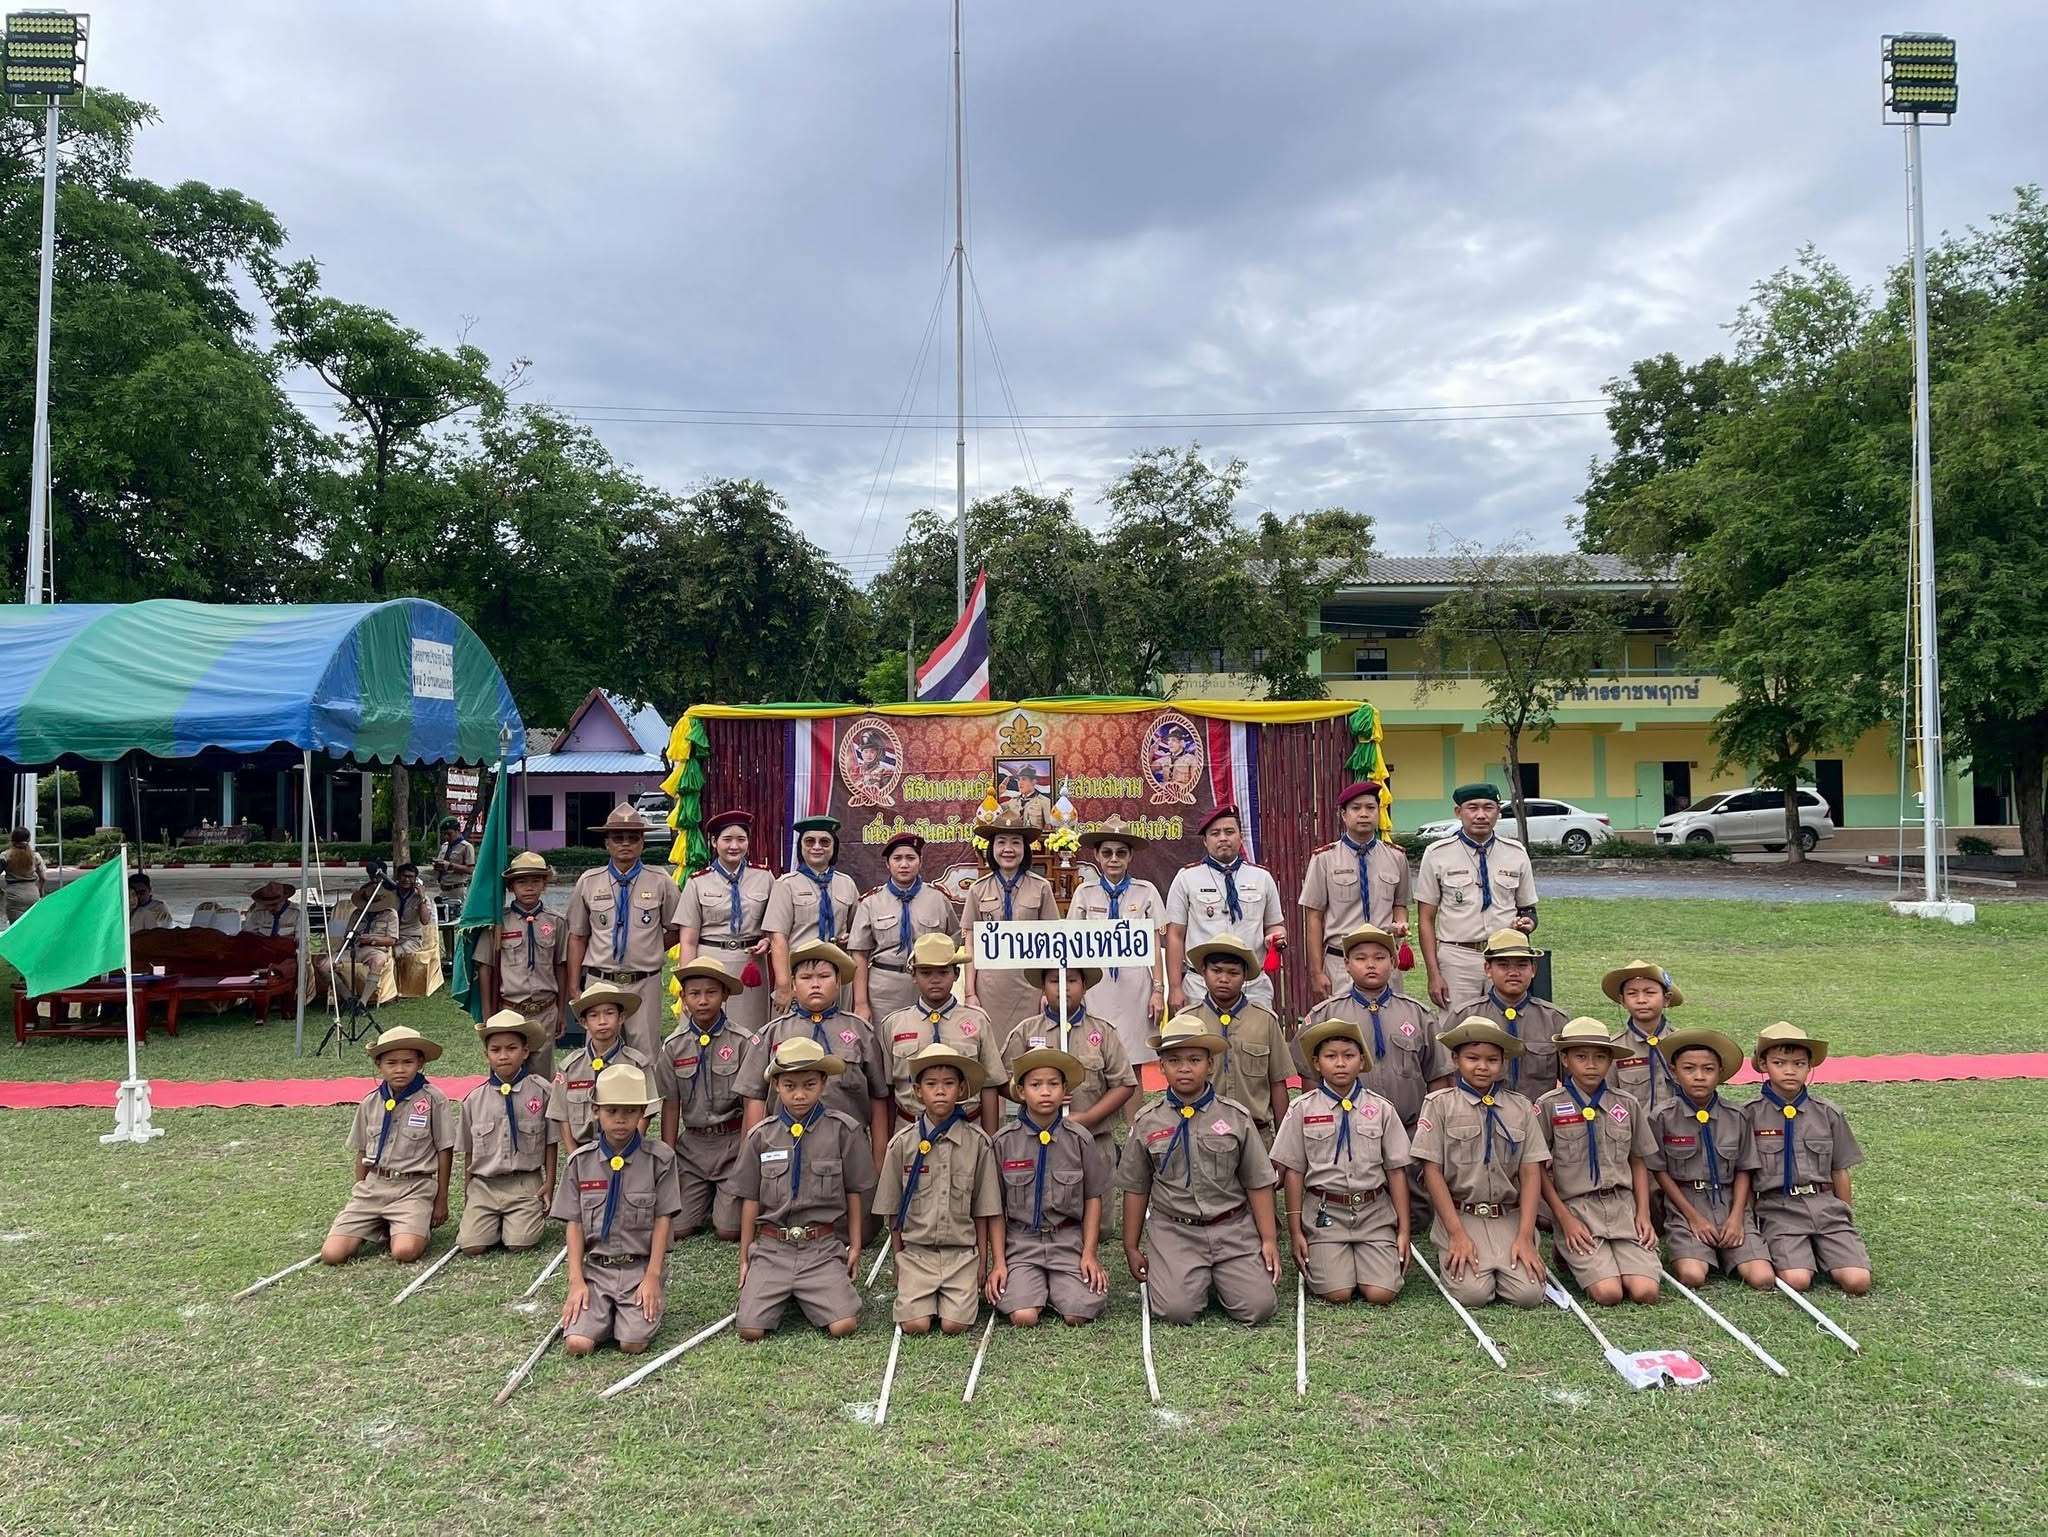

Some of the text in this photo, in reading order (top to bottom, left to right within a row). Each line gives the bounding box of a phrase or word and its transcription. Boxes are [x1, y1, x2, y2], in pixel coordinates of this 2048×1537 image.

[981, 920, 1148, 968] บ้านตลุงเหนือ
